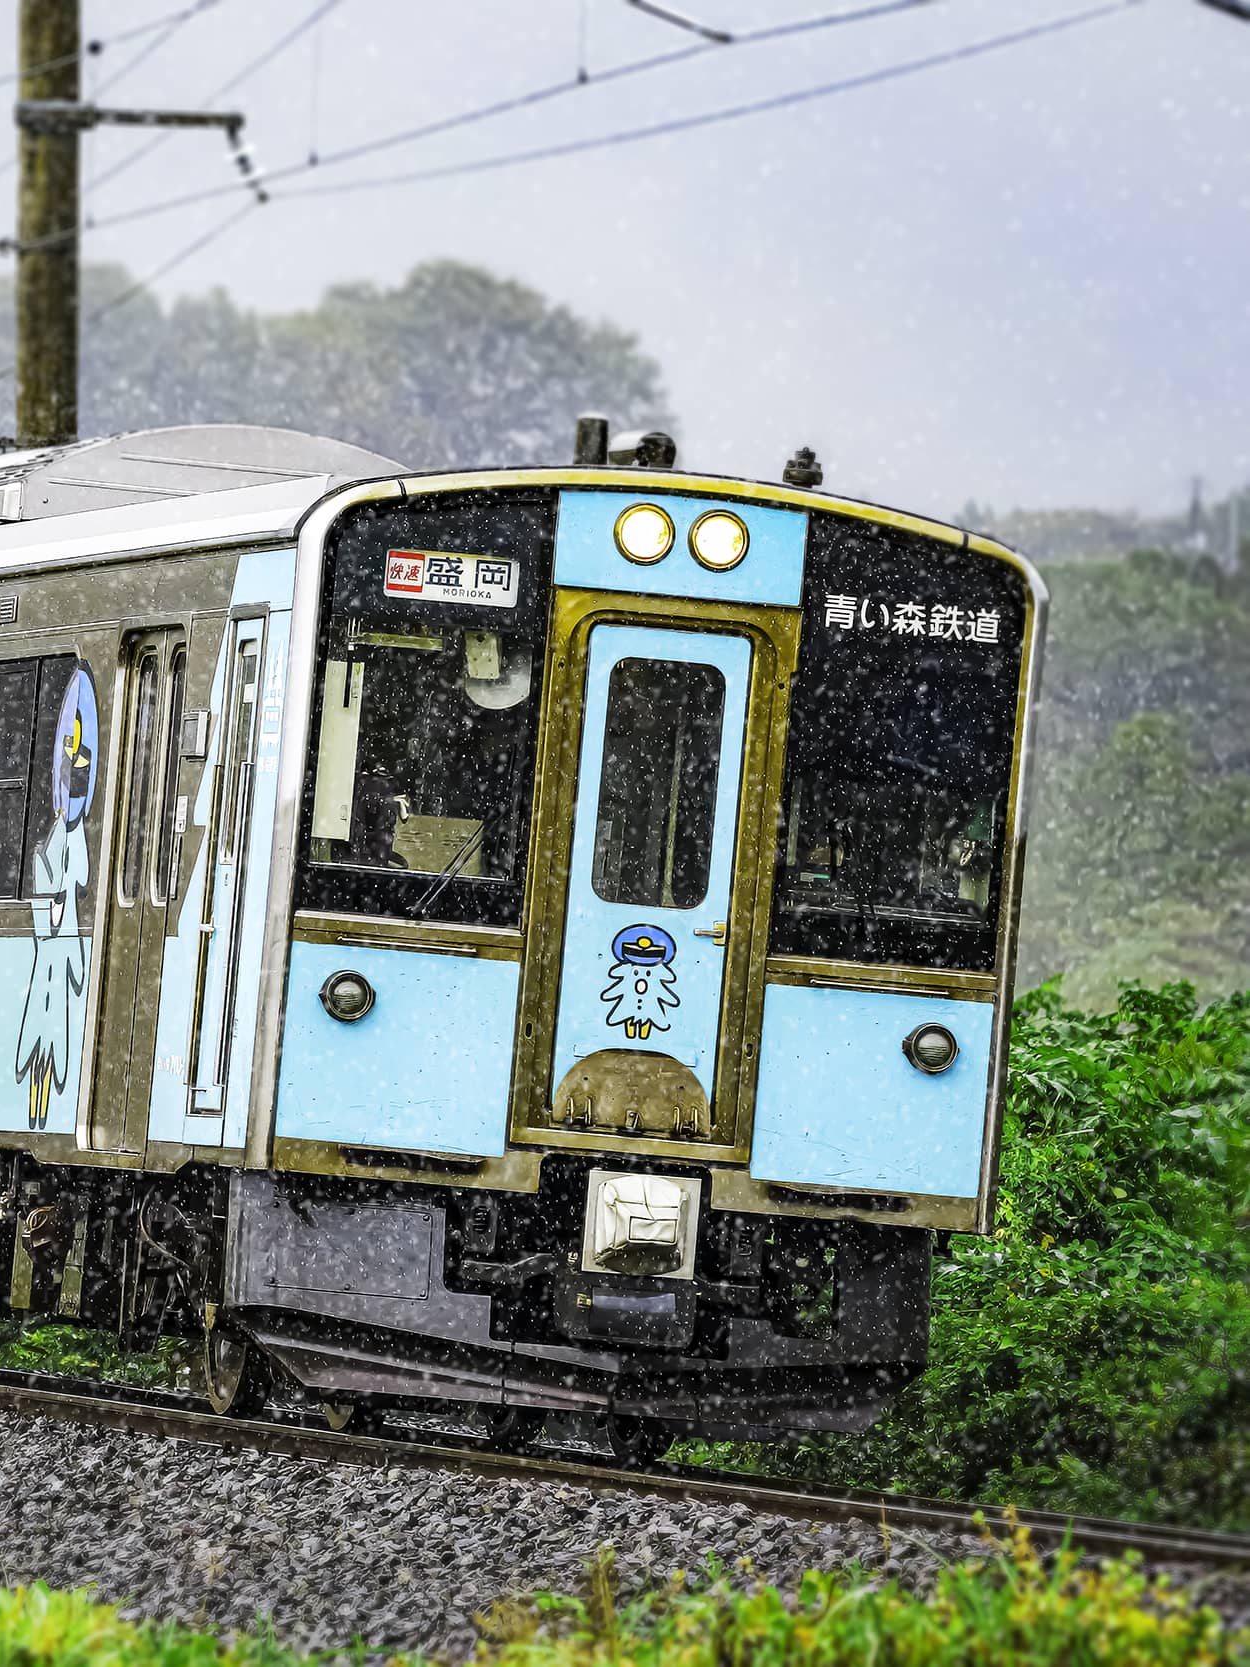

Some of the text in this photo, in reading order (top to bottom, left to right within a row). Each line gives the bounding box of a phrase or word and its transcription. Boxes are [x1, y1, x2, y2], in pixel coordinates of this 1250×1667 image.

[390, 562, 422, 582] 快速
[425, 556, 513, 592] 盛岡
[442, 588, 492, 599] MORIOKA
[823, 593, 1001, 645] 青い森鉄道
